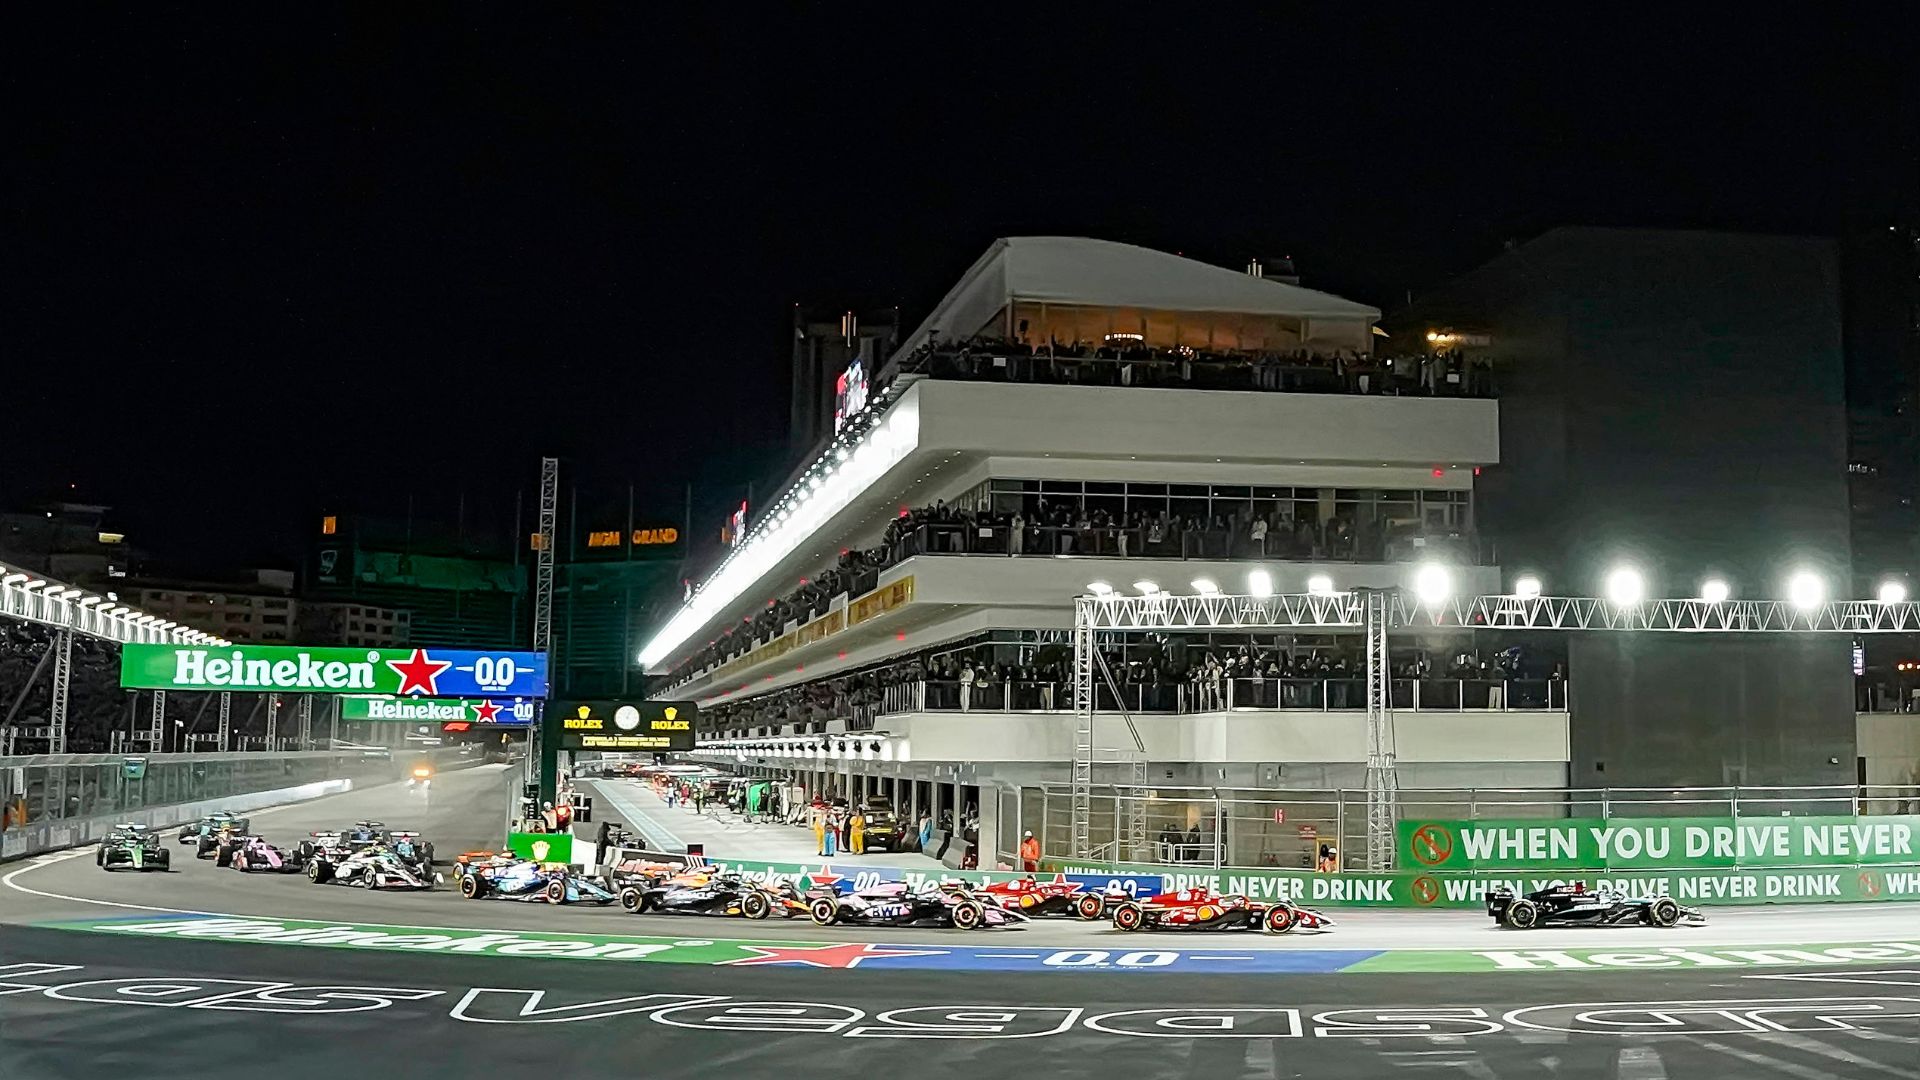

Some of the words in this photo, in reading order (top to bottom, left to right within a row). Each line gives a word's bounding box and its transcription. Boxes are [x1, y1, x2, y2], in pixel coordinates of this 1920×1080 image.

[588, 531, 620, 547] MGM
[632, 527, 678, 545] GRAND
[173, 650, 375, 688] Heineken
[475, 656, 515, 686] 0.0
[367, 700, 467, 720] Heineken
[563, 719, 603, 729] ROLEX
[650, 720, 690, 731] ROLEX
[1460, 827, 1578, 860] WHEN
[1589, 826, 1670, 860] YOU
[1685, 825, 1790, 859] DRIVE
[1803, 823, 1913, 856] NEVER
[1164, 872, 1220, 896] DRIVE
[1230, 875, 1305, 900] NEVER
[1312, 878, 1393, 902] DRINK
[1443, 879, 1523, 902] WHEN
[1596, 878, 1669, 899] DRIVE
[1678, 876, 1758, 899] NEVER
[1765, 874, 1842, 897] DRINK
[872, 905, 901, 918] BWT
[93, 918, 675, 958] Heineken
[1042, 950, 1180, 967] 0.0
[449, 987, 1505, 1039] Vegas
